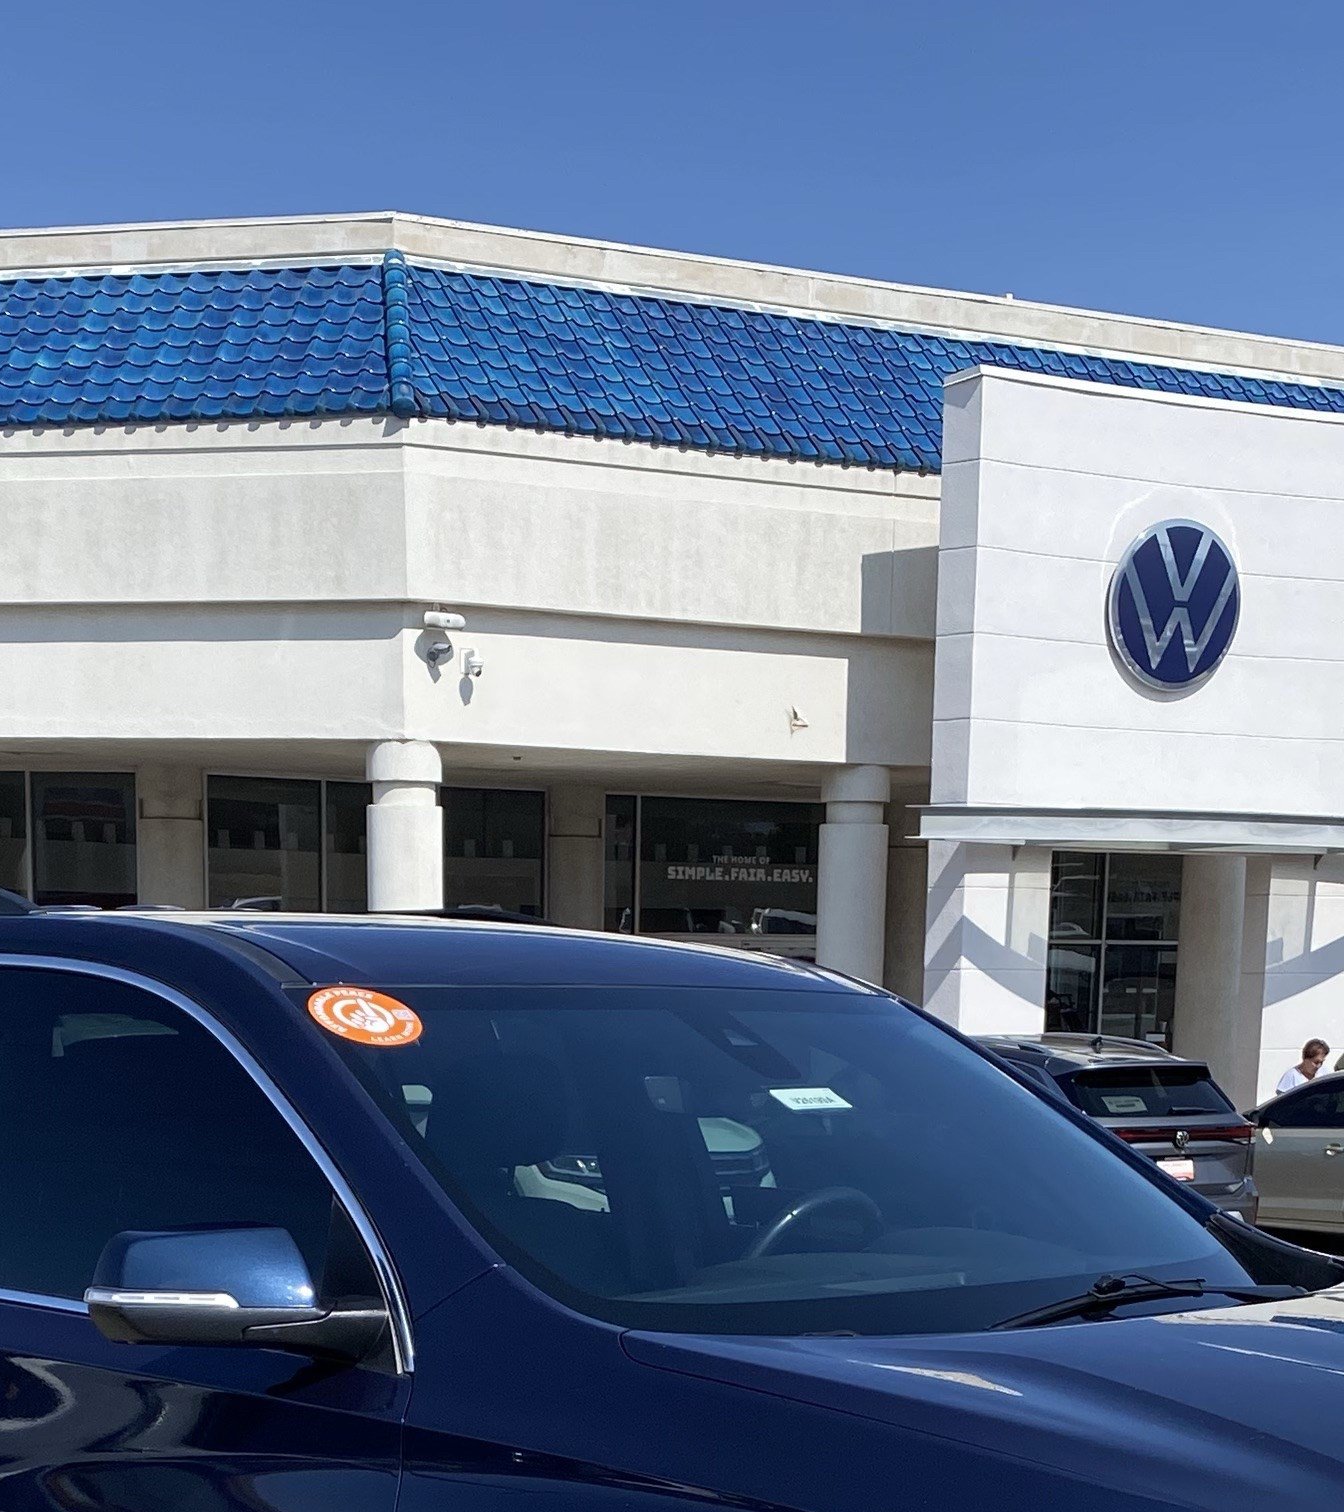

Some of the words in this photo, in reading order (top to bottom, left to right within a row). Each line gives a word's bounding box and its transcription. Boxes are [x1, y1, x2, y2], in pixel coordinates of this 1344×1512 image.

[712, 854, 729, 864] THE
[731, 855, 757, 865] HOME
[759, 856, 770, 865] OF
